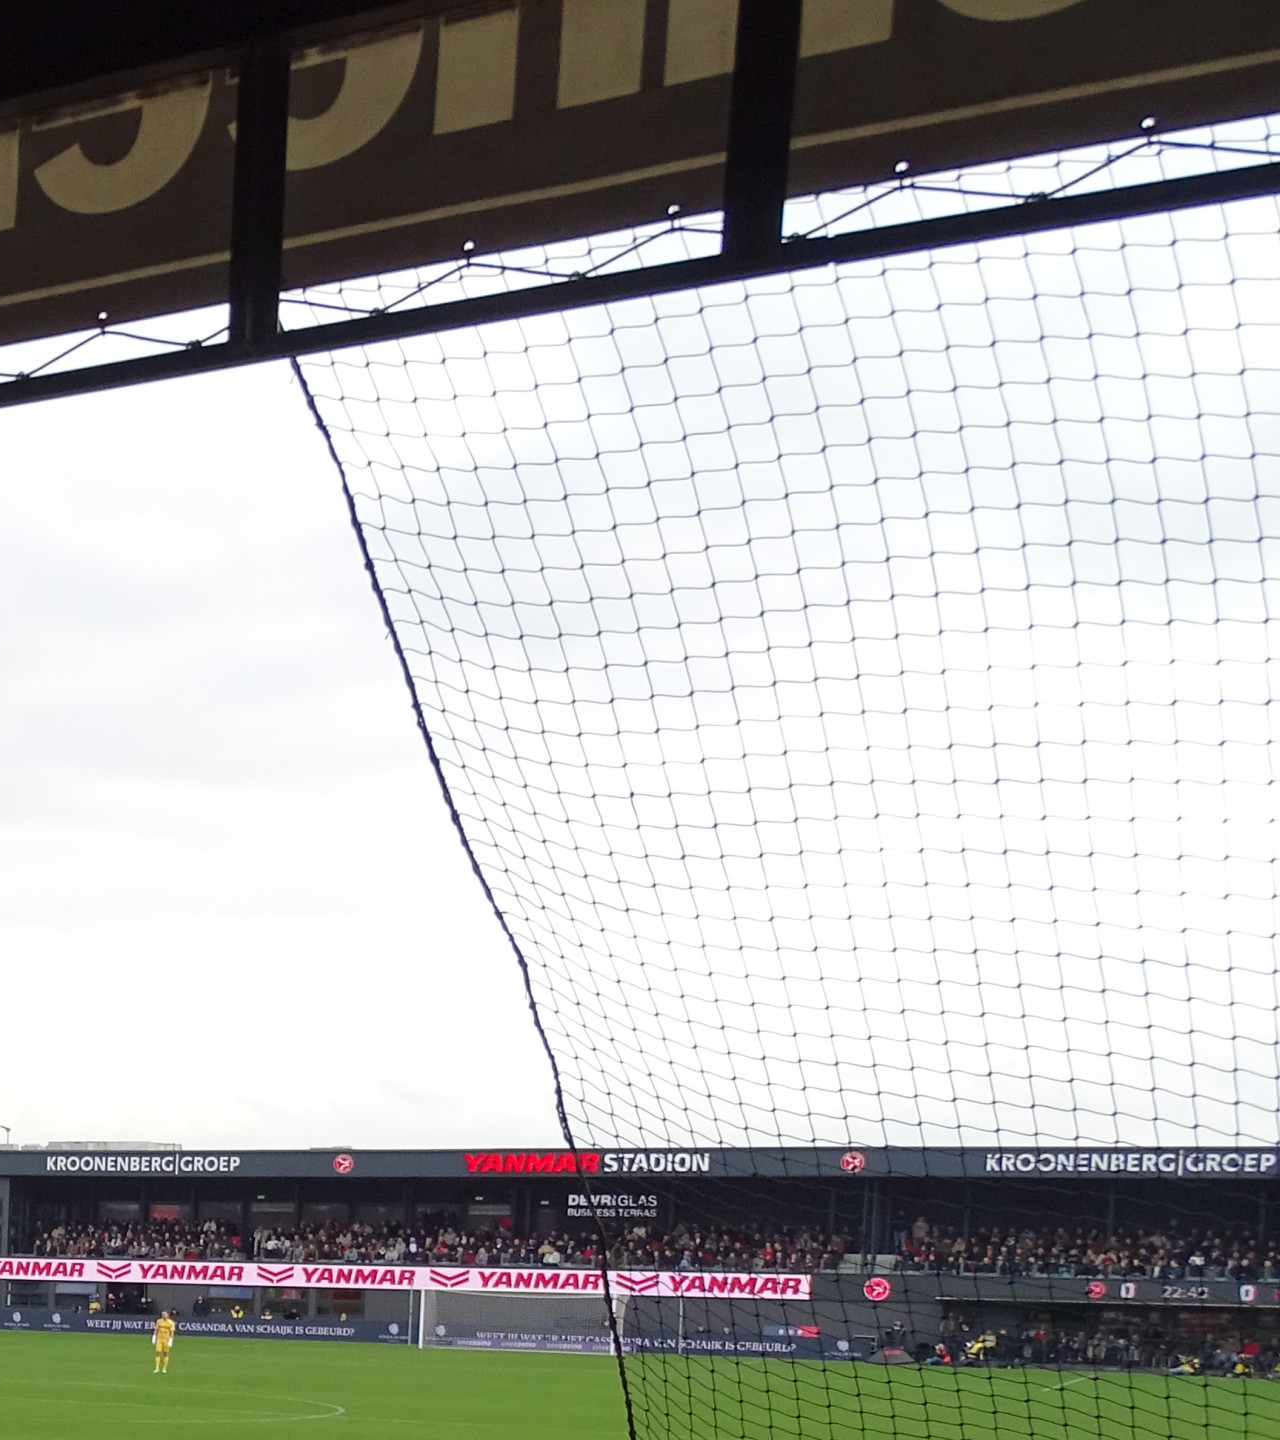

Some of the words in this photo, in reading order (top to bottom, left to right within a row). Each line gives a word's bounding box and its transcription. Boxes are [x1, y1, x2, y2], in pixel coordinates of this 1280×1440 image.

[463, 1152, 601, 1174] YANMAR
[603, 1152, 710, 1174] STADION
[567, 1208, 617, 1218] BUSIESS
[138, 1263, 244, 1282] YANMAR
[301, 1267, 416, 1286] YANMAR
[477, 1270, 602, 1290] YANMAR
[668, 1274, 802, 1295] YANMAR
[86, 1319, 111, 1329] WEET
[123, 1320, 143, 1330] WAT
[178, 1322, 233, 1333] CASSANDRA
[235, 1324, 254, 1334] VAN
[255, 1325, 293, 1336] SCHAIJK
[295, 1326, 304, 1335] IS
[305, 1326, 355, 1337] GEBEURD?
[724, 1341, 735, 1350] IS
